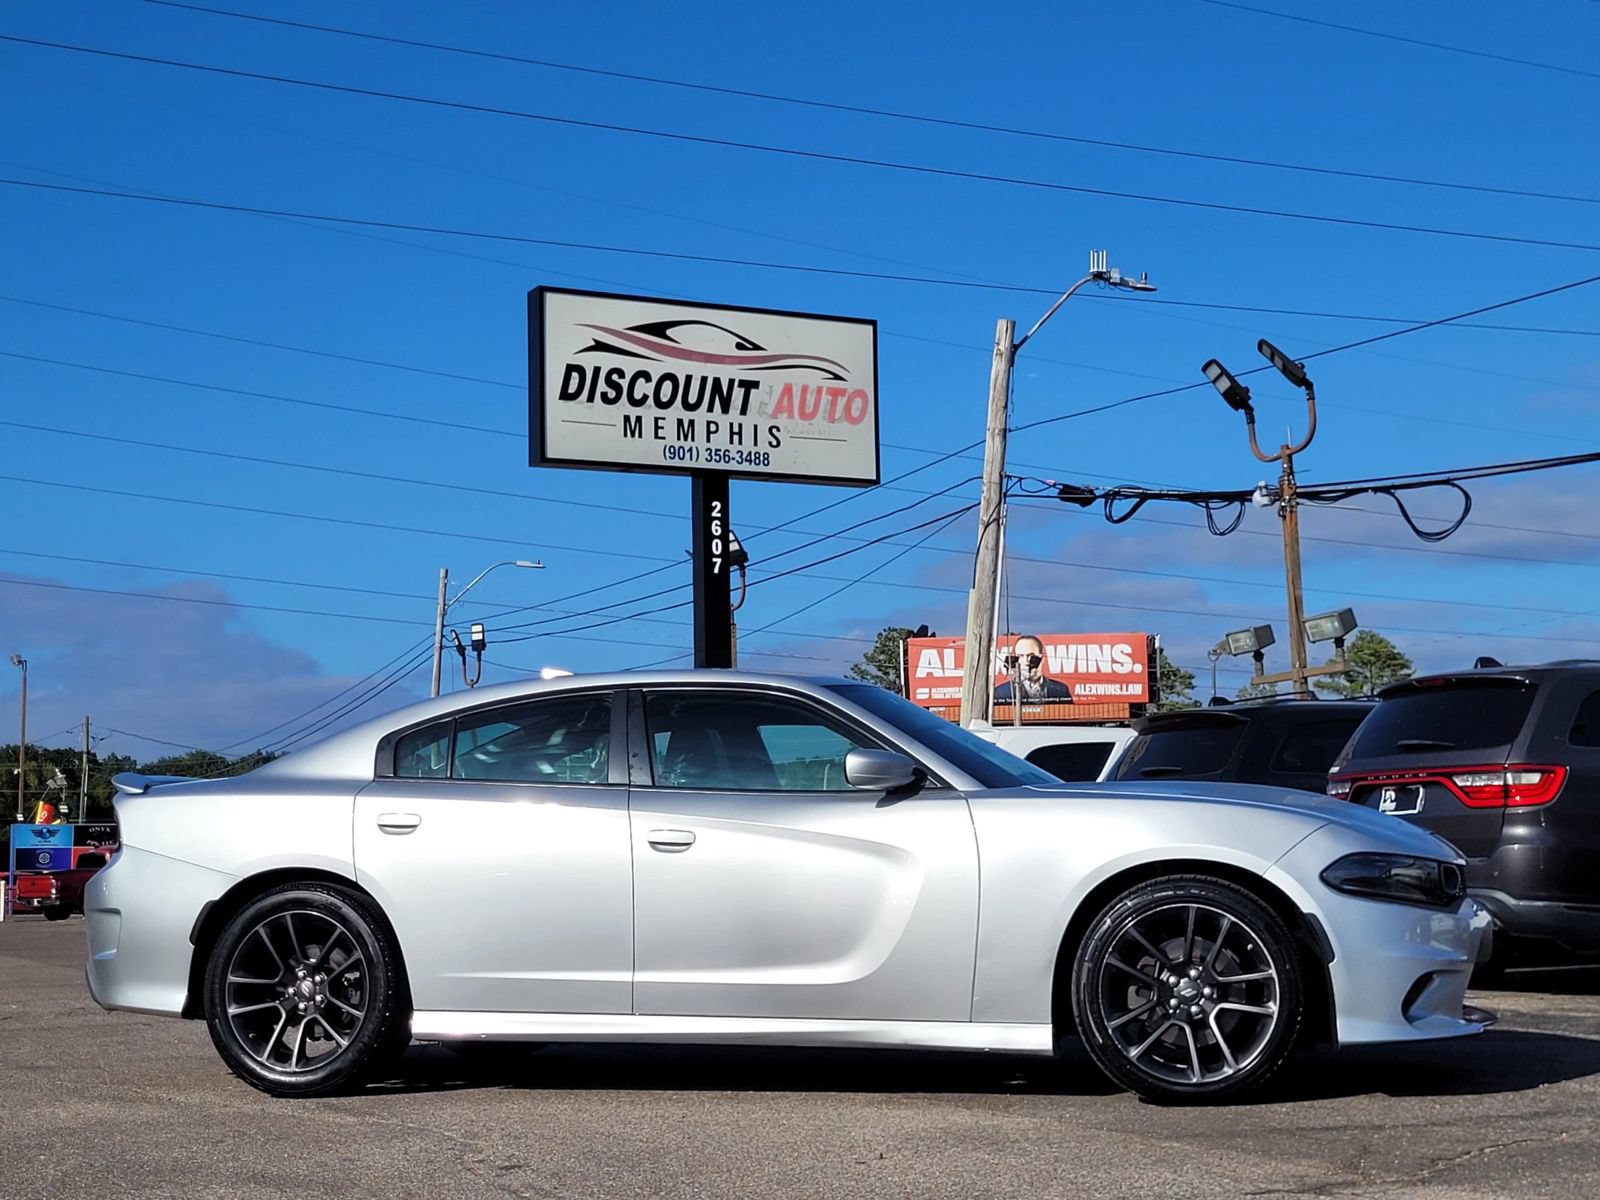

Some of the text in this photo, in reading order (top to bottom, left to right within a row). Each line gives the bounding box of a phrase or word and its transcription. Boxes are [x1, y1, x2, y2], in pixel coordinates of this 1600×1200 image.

[558, 363, 869, 426] DISCOUNT AUTO
[623, 414, 781, 449] MEMPHIS
[663, 444, 770, 467] (901) 356-3488
[711, 501, 722, 574] 2607
[1047, 643, 1143, 674] WINS.
[1074, 683, 1143, 696] ALEXWINS.LAW
